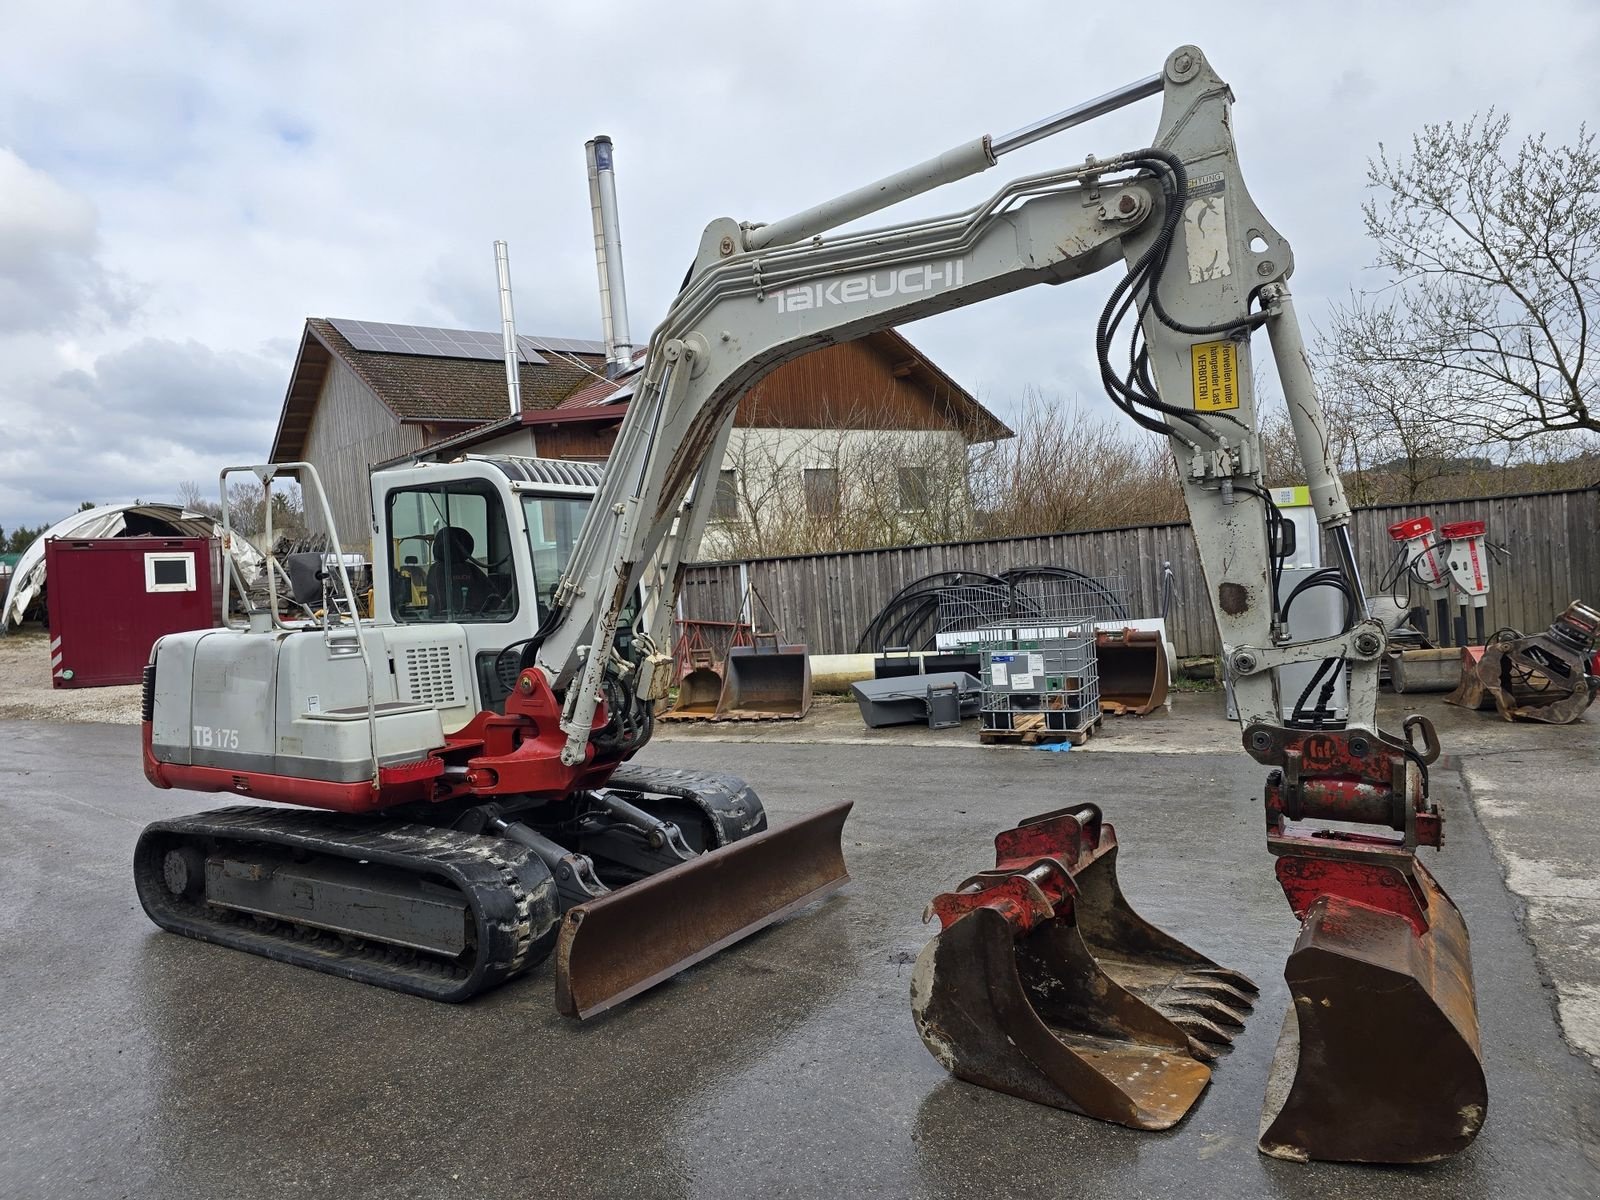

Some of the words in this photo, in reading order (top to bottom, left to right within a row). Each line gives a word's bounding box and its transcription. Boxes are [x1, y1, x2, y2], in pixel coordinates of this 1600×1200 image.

[1209, 345, 1220, 386] hängender
[1222, 342, 1232, 383] Verweilen
[1212, 388, 1221, 405] Last
[1224, 383, 1233, 404] unter
[193, 725, 213, 747] TB
[215, 728, 239, 749] 175
